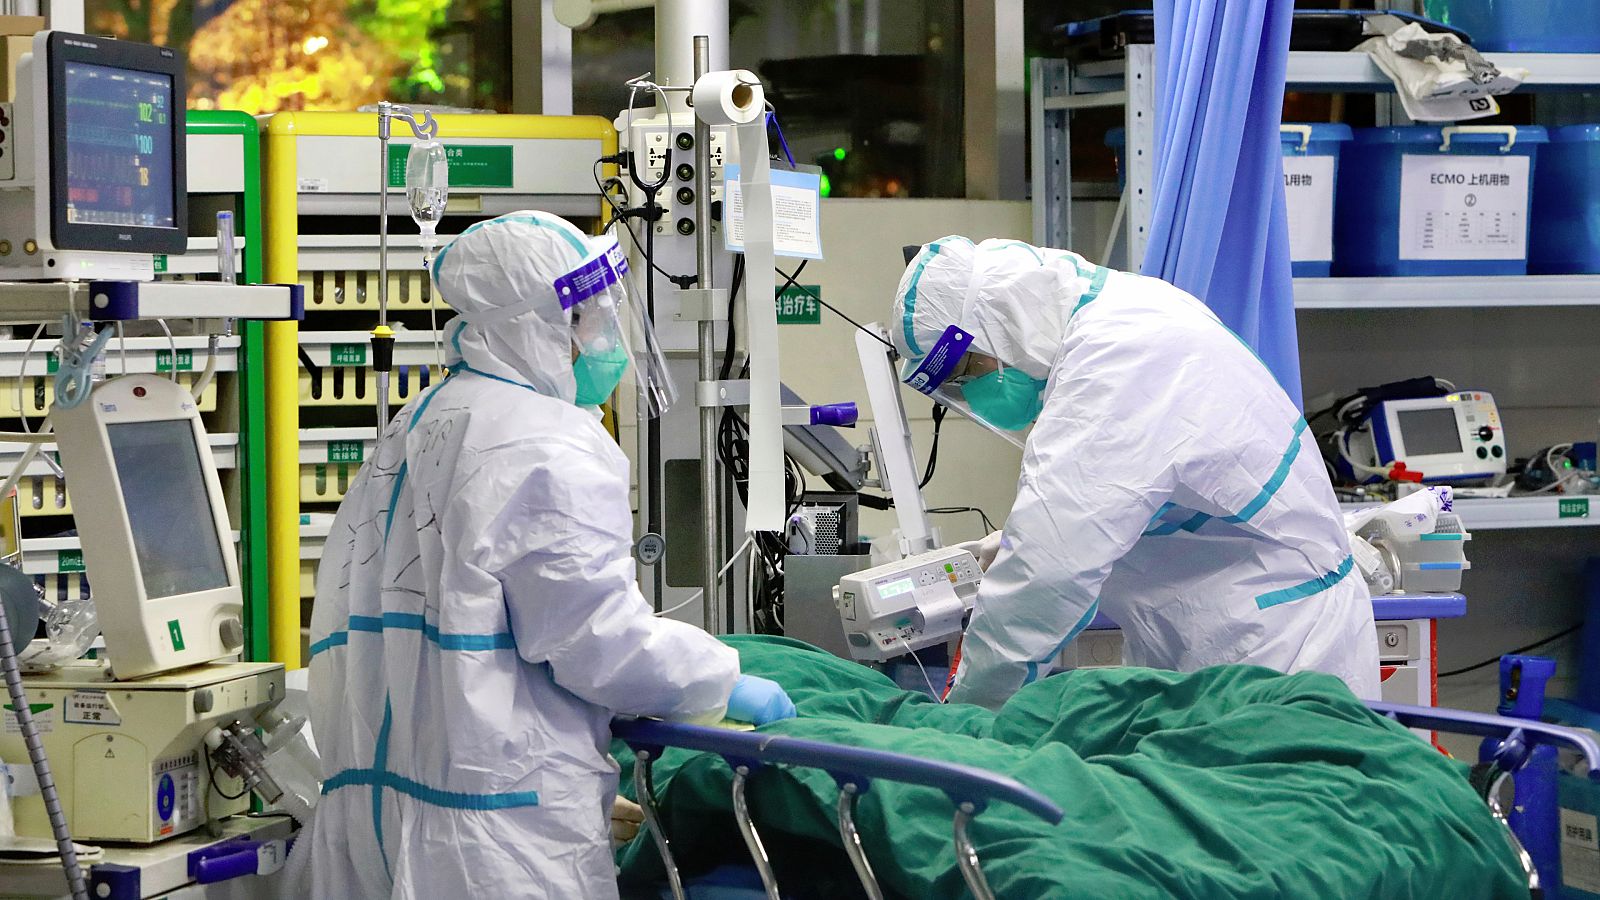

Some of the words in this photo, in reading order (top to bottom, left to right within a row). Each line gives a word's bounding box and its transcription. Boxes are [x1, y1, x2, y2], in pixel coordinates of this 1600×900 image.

[1430, 173, 1465, 185] ECMO
[1467, 173, 1510, 186] 上机用物
